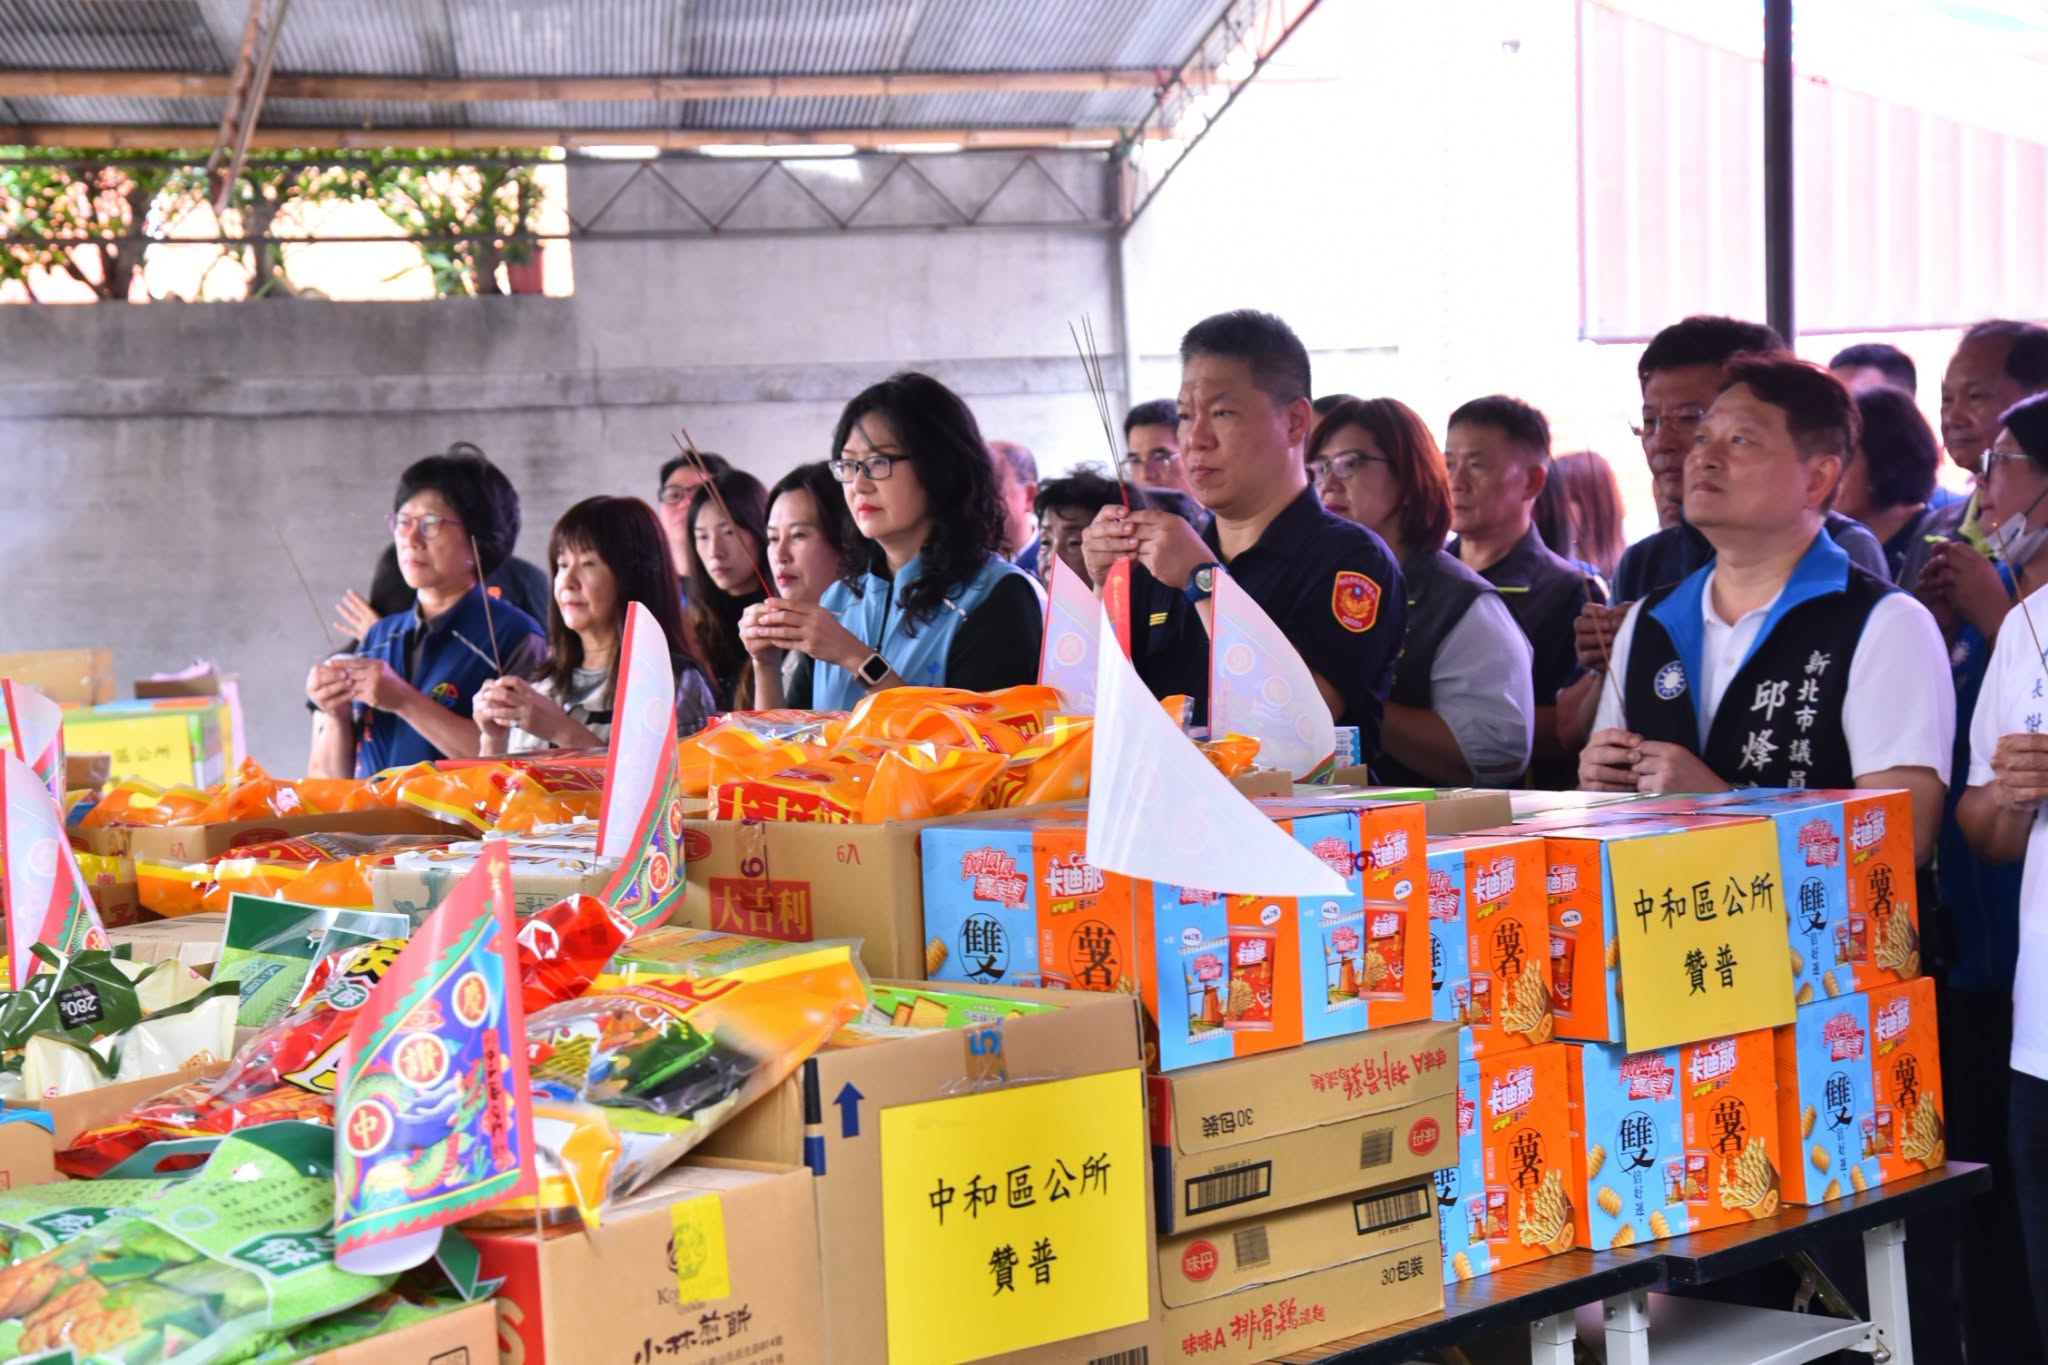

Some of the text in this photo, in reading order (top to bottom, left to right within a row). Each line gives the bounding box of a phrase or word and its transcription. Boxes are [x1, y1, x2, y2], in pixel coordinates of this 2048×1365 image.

[1738, 680, 1790, 788] 邱烽
[1787, 649, 1831, 789] 新北市議員
[837, 843, 862, 865] 6入
[1044, 855, 1105, 898] 卡迪那
[715, 883, 807, 936] 大吉利
[1472, 866, 1516, 905] 卡迪那
[1546, 873, 1578, 895] 迪那
[1633, 872, 1775, 934] 中和區公所
[1866, 867, 1894, 918] 薯
[962, 917, 1006, 980] 雙
[1073, 925, 1118, 987] 薯
[1492, 922, 1525, 978] 薯
[1688, 1048, 1736, 1084] 卡迪那
[1891, 1058, 1919, 1109] 薯
[1487, 1077, 1535, 1117] 卡迪那
[353, 1107, 379, 1150] 中
[1201, 1107, 1255, 1140] 30包裝
[1620, 1115, 1655, 1174] 雙
[1710, 1100, 1747, 1155] 薯
[1510, 1132, 1544, 1190] 薯
[928, 1153, 1112, 1227] 中和區公所
[1185, 1250, 1215, 1274] 味丹
[1381, 1255, 1425, 1286] 30包裝
[634, 1304, 752, 1365] 小林煎餅
[1181, 1326, 1228, 1358] 味味A
